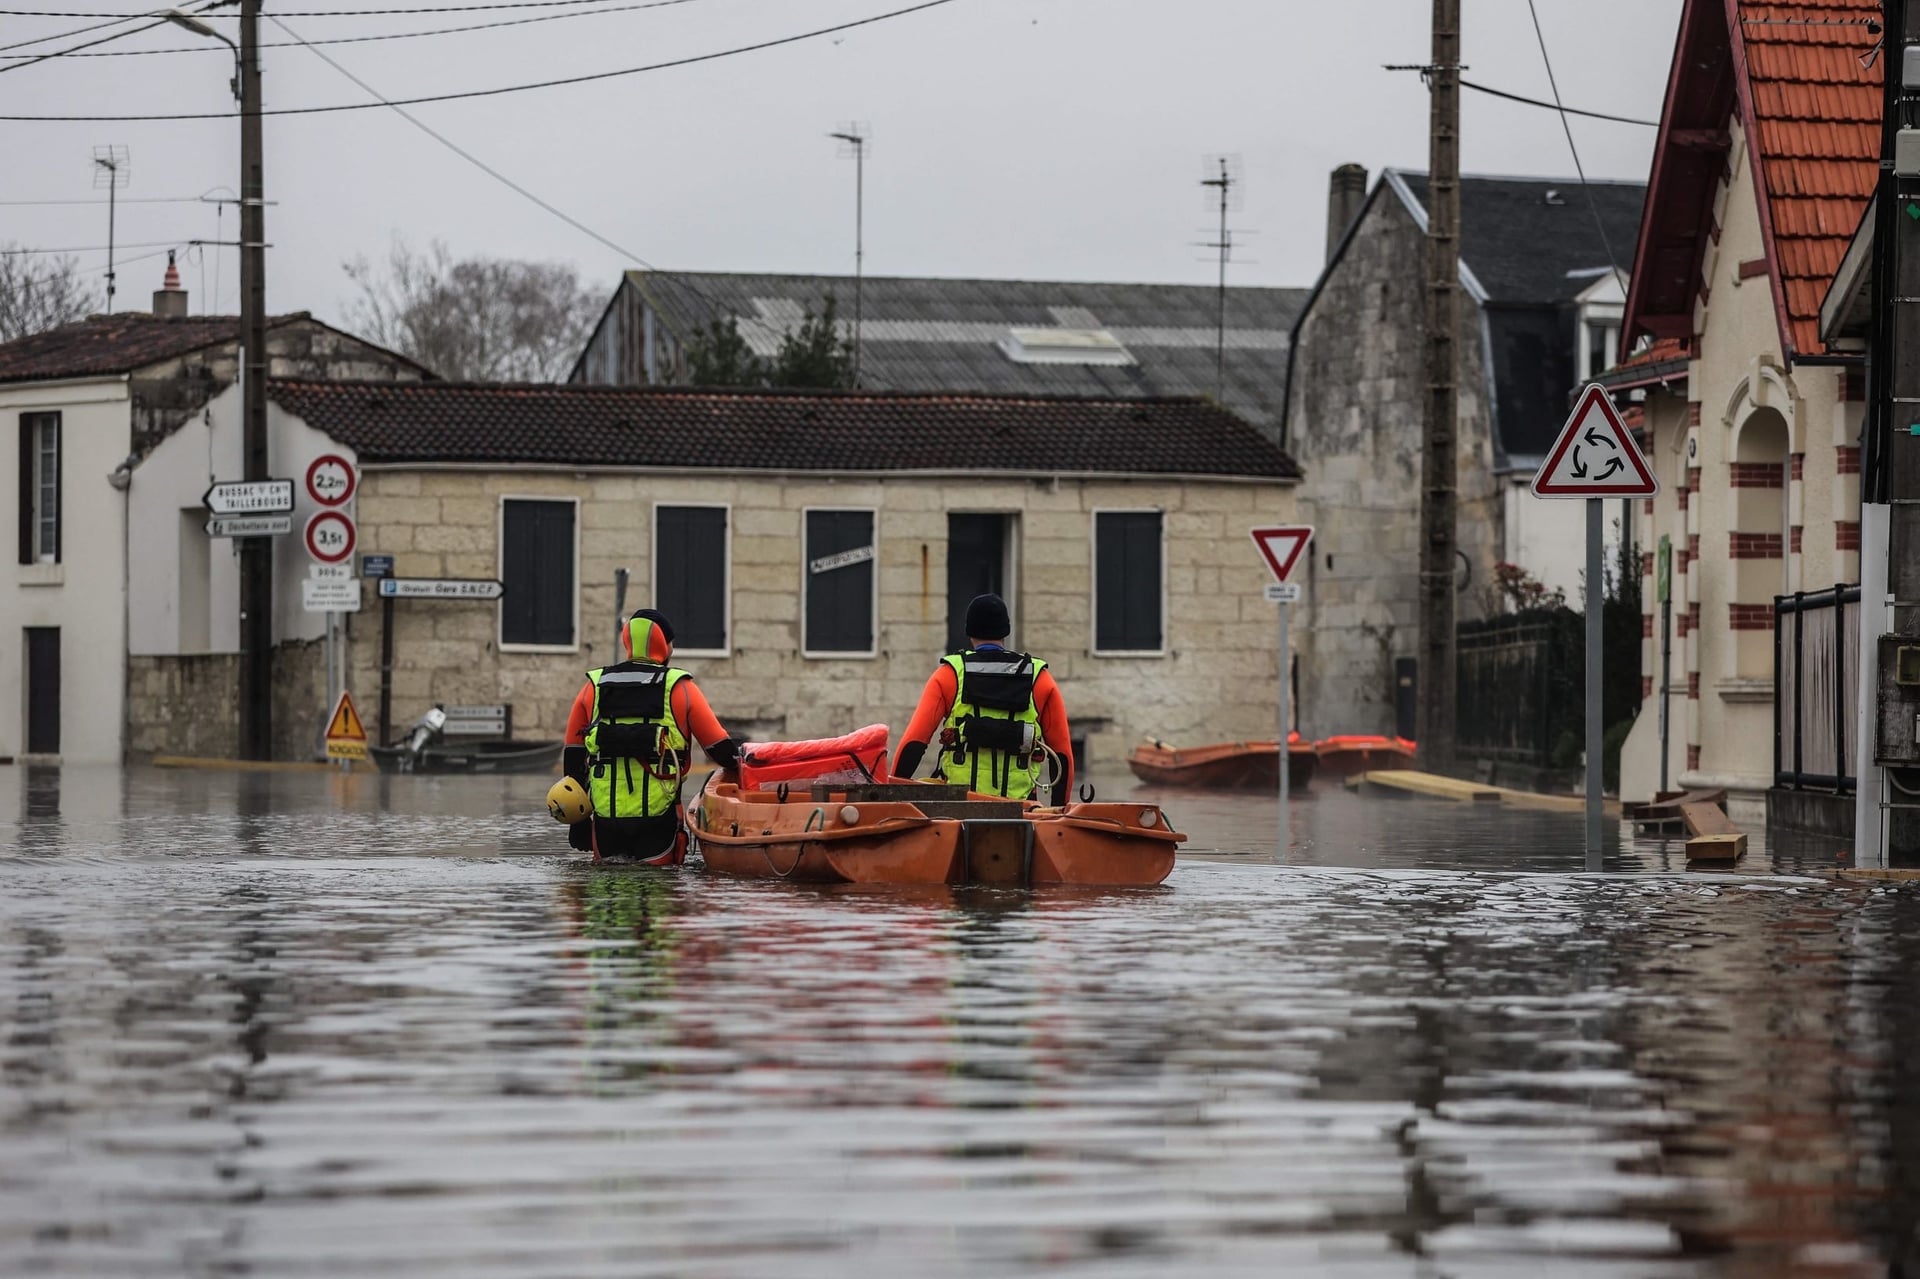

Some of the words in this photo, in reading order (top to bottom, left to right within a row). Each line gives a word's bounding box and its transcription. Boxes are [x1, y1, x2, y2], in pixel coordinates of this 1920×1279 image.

[316, 474, 346, 489] 2,2m
[219, 487, 254, 498] BUSSAC
[226, 496, 289, 508] TAILLEBOURG
[319, 530, 343, 545] 3,5t
[435, 583, 457, 593] Gare
